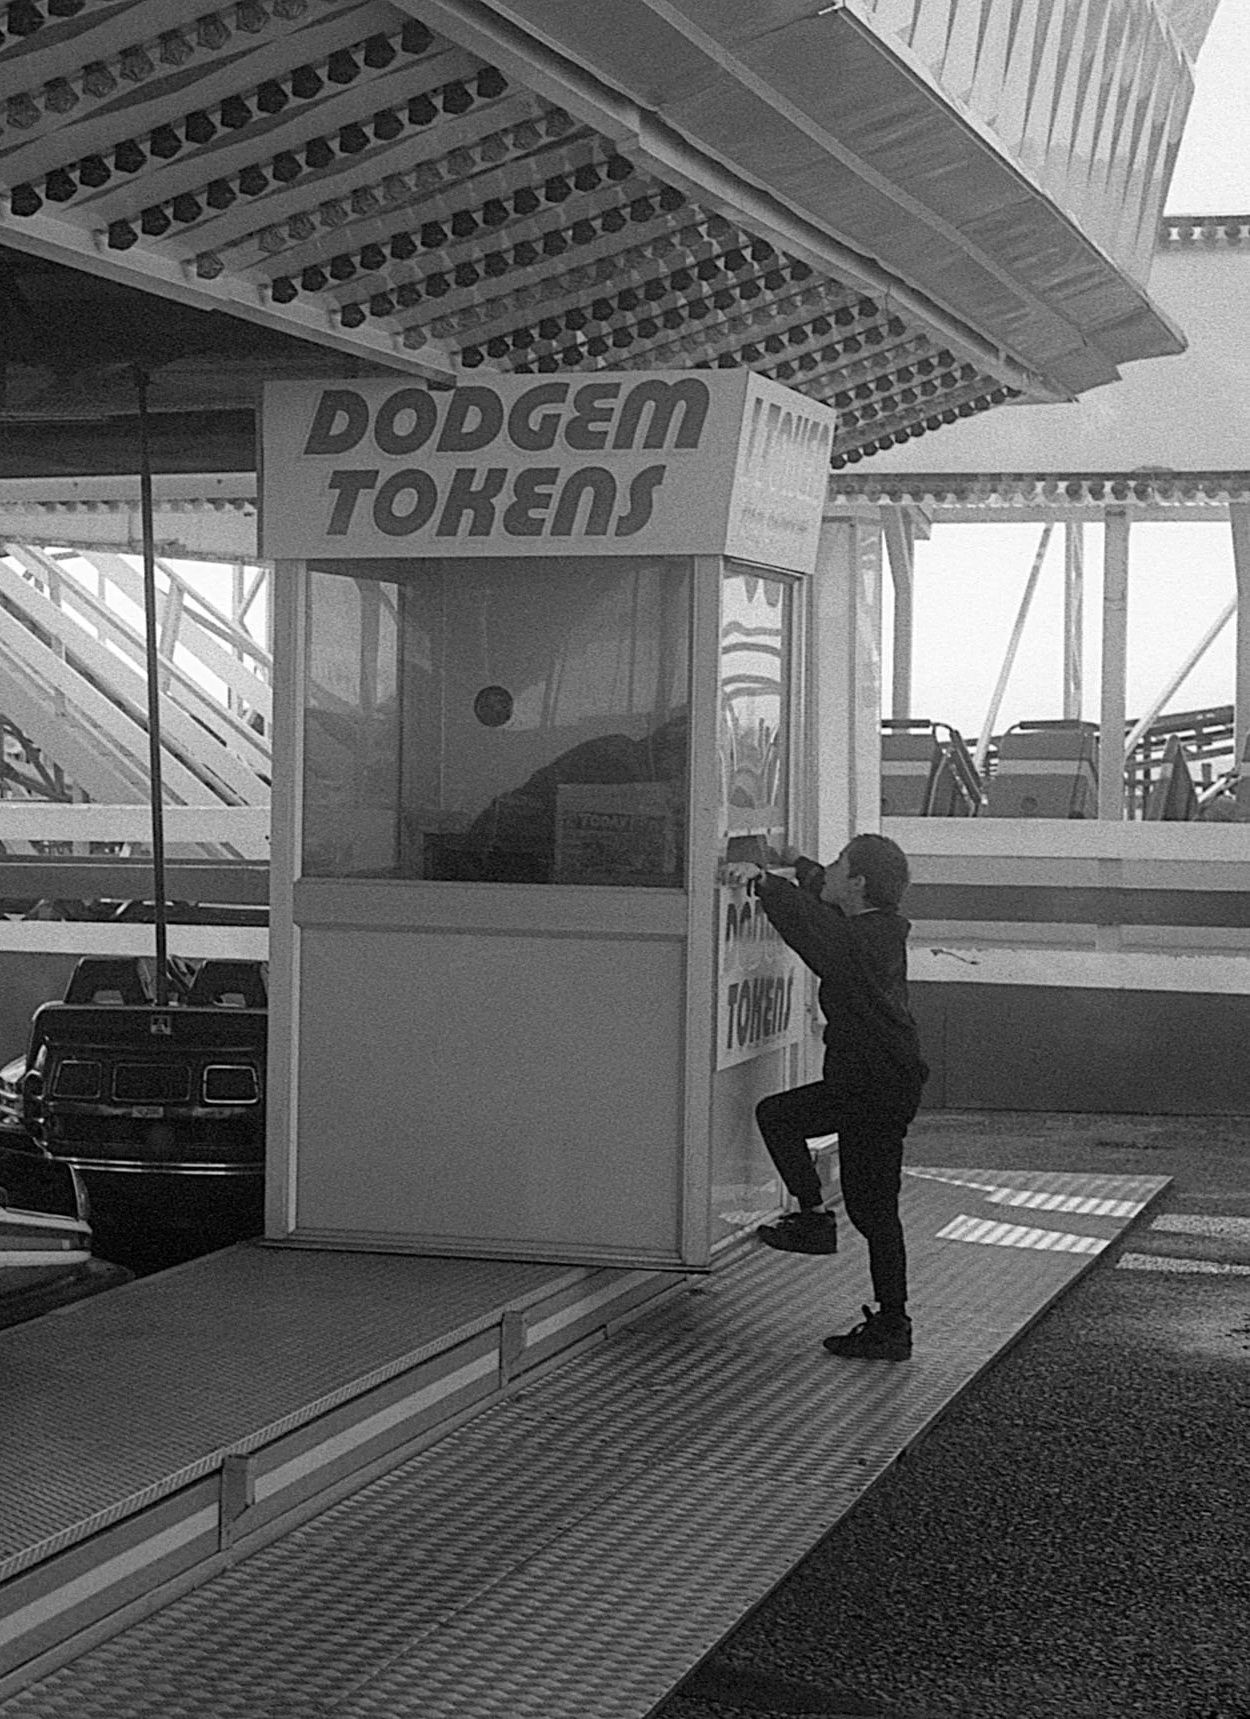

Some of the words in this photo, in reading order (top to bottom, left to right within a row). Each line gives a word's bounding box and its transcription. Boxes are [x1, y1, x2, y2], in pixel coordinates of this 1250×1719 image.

[303, 377, 710, 455] DODGEM
[326, 464, 667, 537] TOKENS
[726, 966, 796, 1049] TOKENS
